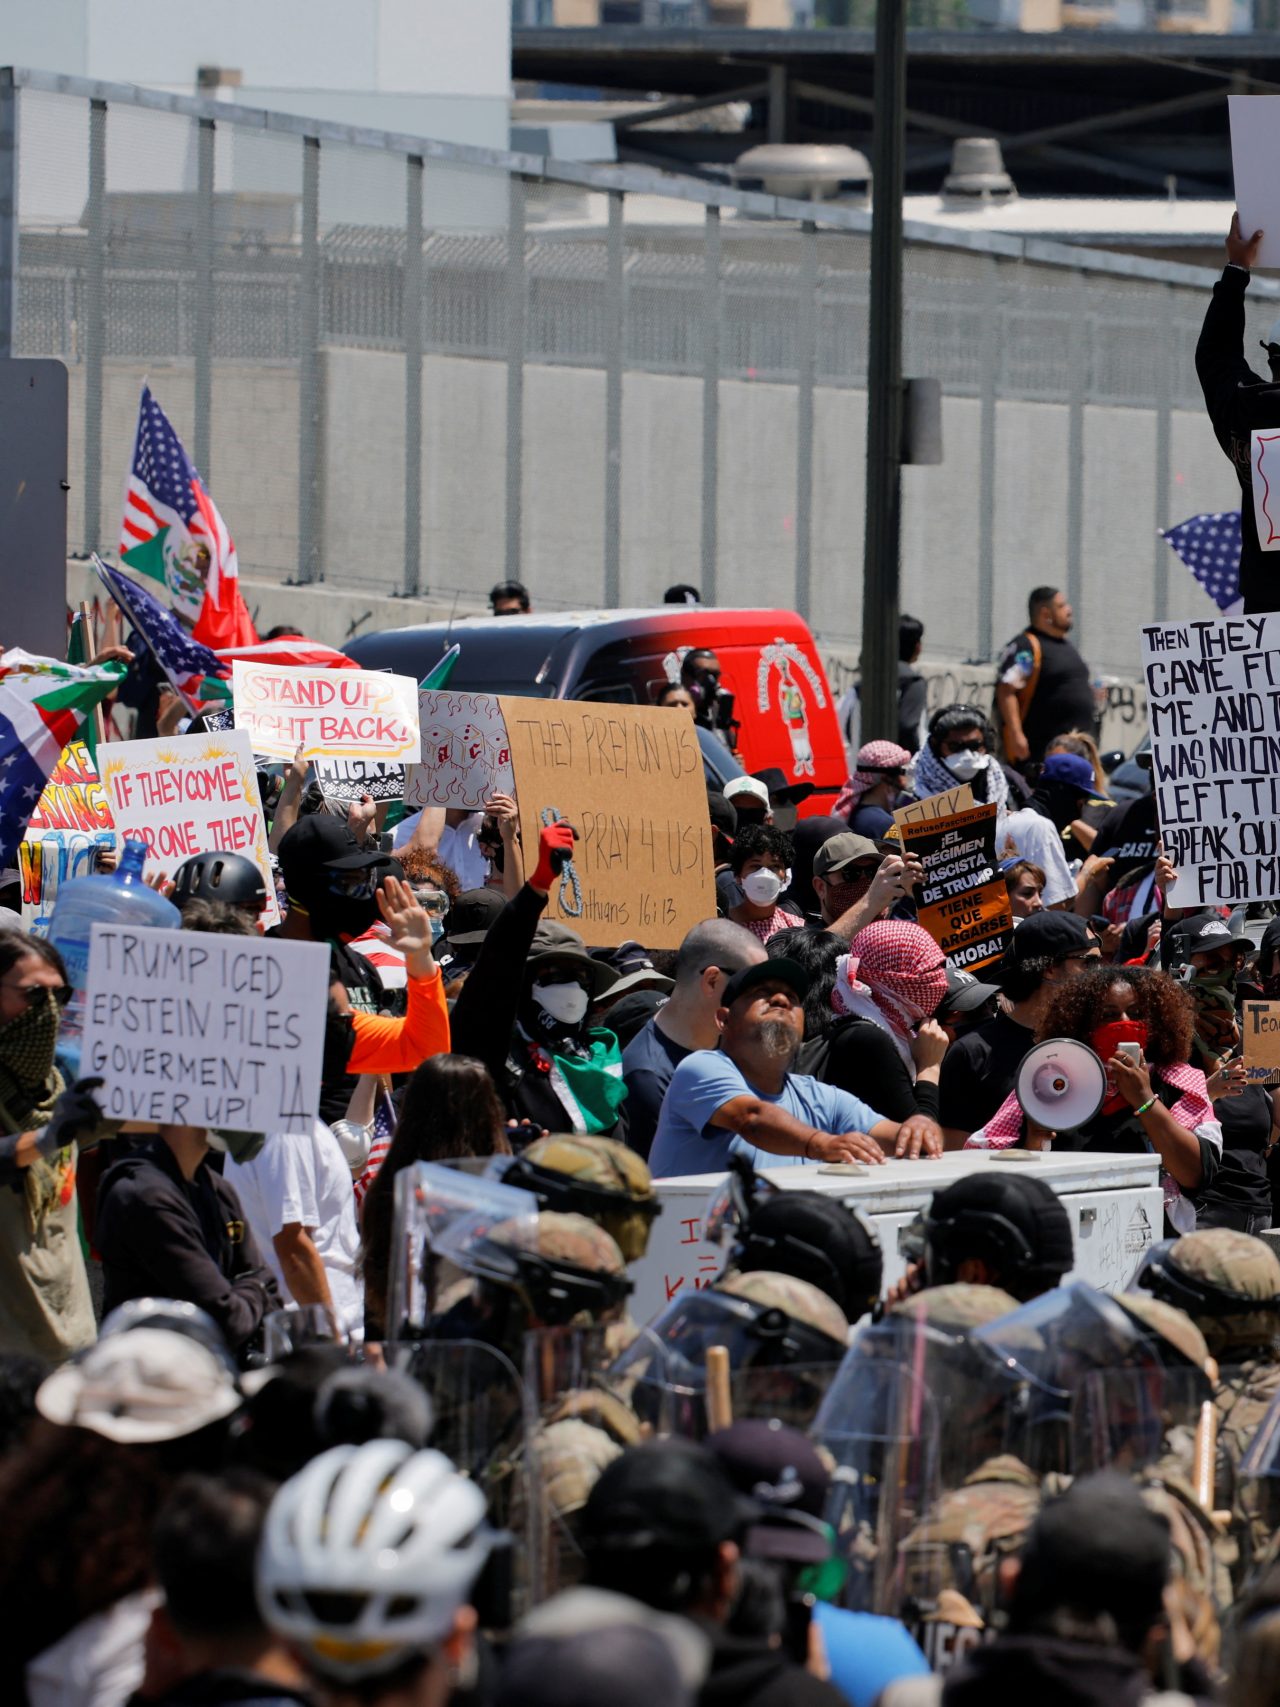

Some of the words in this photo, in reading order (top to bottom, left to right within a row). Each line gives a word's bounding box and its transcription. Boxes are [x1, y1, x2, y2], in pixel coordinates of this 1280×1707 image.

[1143, 627, 1190, 651] THEN
[1190, 618, 1266, 658] THEY
[249, 676, 336, 706] STAND
[1147, 658, 1233, 697] CAME
[320, 716, 408, 742] BACK!
[1212, 692, 1264, 734] AND
[517, 719, 572, 768] THEY
[582, 714, 630, 778] PREY
[635, 723, 660, 774] ON
[664, 726, 699, 779] US
[1154, 739, 1206, 782] WAS
[114, 773, 133, 809] IF
[137, 768, 184, 807] THEY
[185, 762, 242, 801] COME
[28, 783, 115, 832] AYING
[907, 809, 991, 836] RefuseFascism.org
[207, 814, 258, 851] THEY
[582, 812, 630, 874] PRAY
[641, 817, 655, 873] 4
[667, 820, 705, 888] US!
[1162, 825, 1235, 868] SPEAK
[922, 837, 985, 869] RÉGIMEN
[922, 887, 944, 904] DE
[947, 867, 994, 896] TRUMP
[1198, 860, 1250, 903] FOR
[938, 893, 983, 918] TIENE
[951, 908, 983, 930] QUE
[940, 914, 1009, 950] ARGARSE
[99, 933, 208, 983] TRUMP
[221, 949, 283, 999] ICED
[945, 937, 1003, 969] AHORA!
[93, 993, 210, 1038] EPSTEIN
[223, 1003, 302, 1050] FILES
[91, 1041, 266, 1094] GOVERMENT
[101, 1087, 190, 1126] OVER
[204, 1095, 253, 1127] UP!
